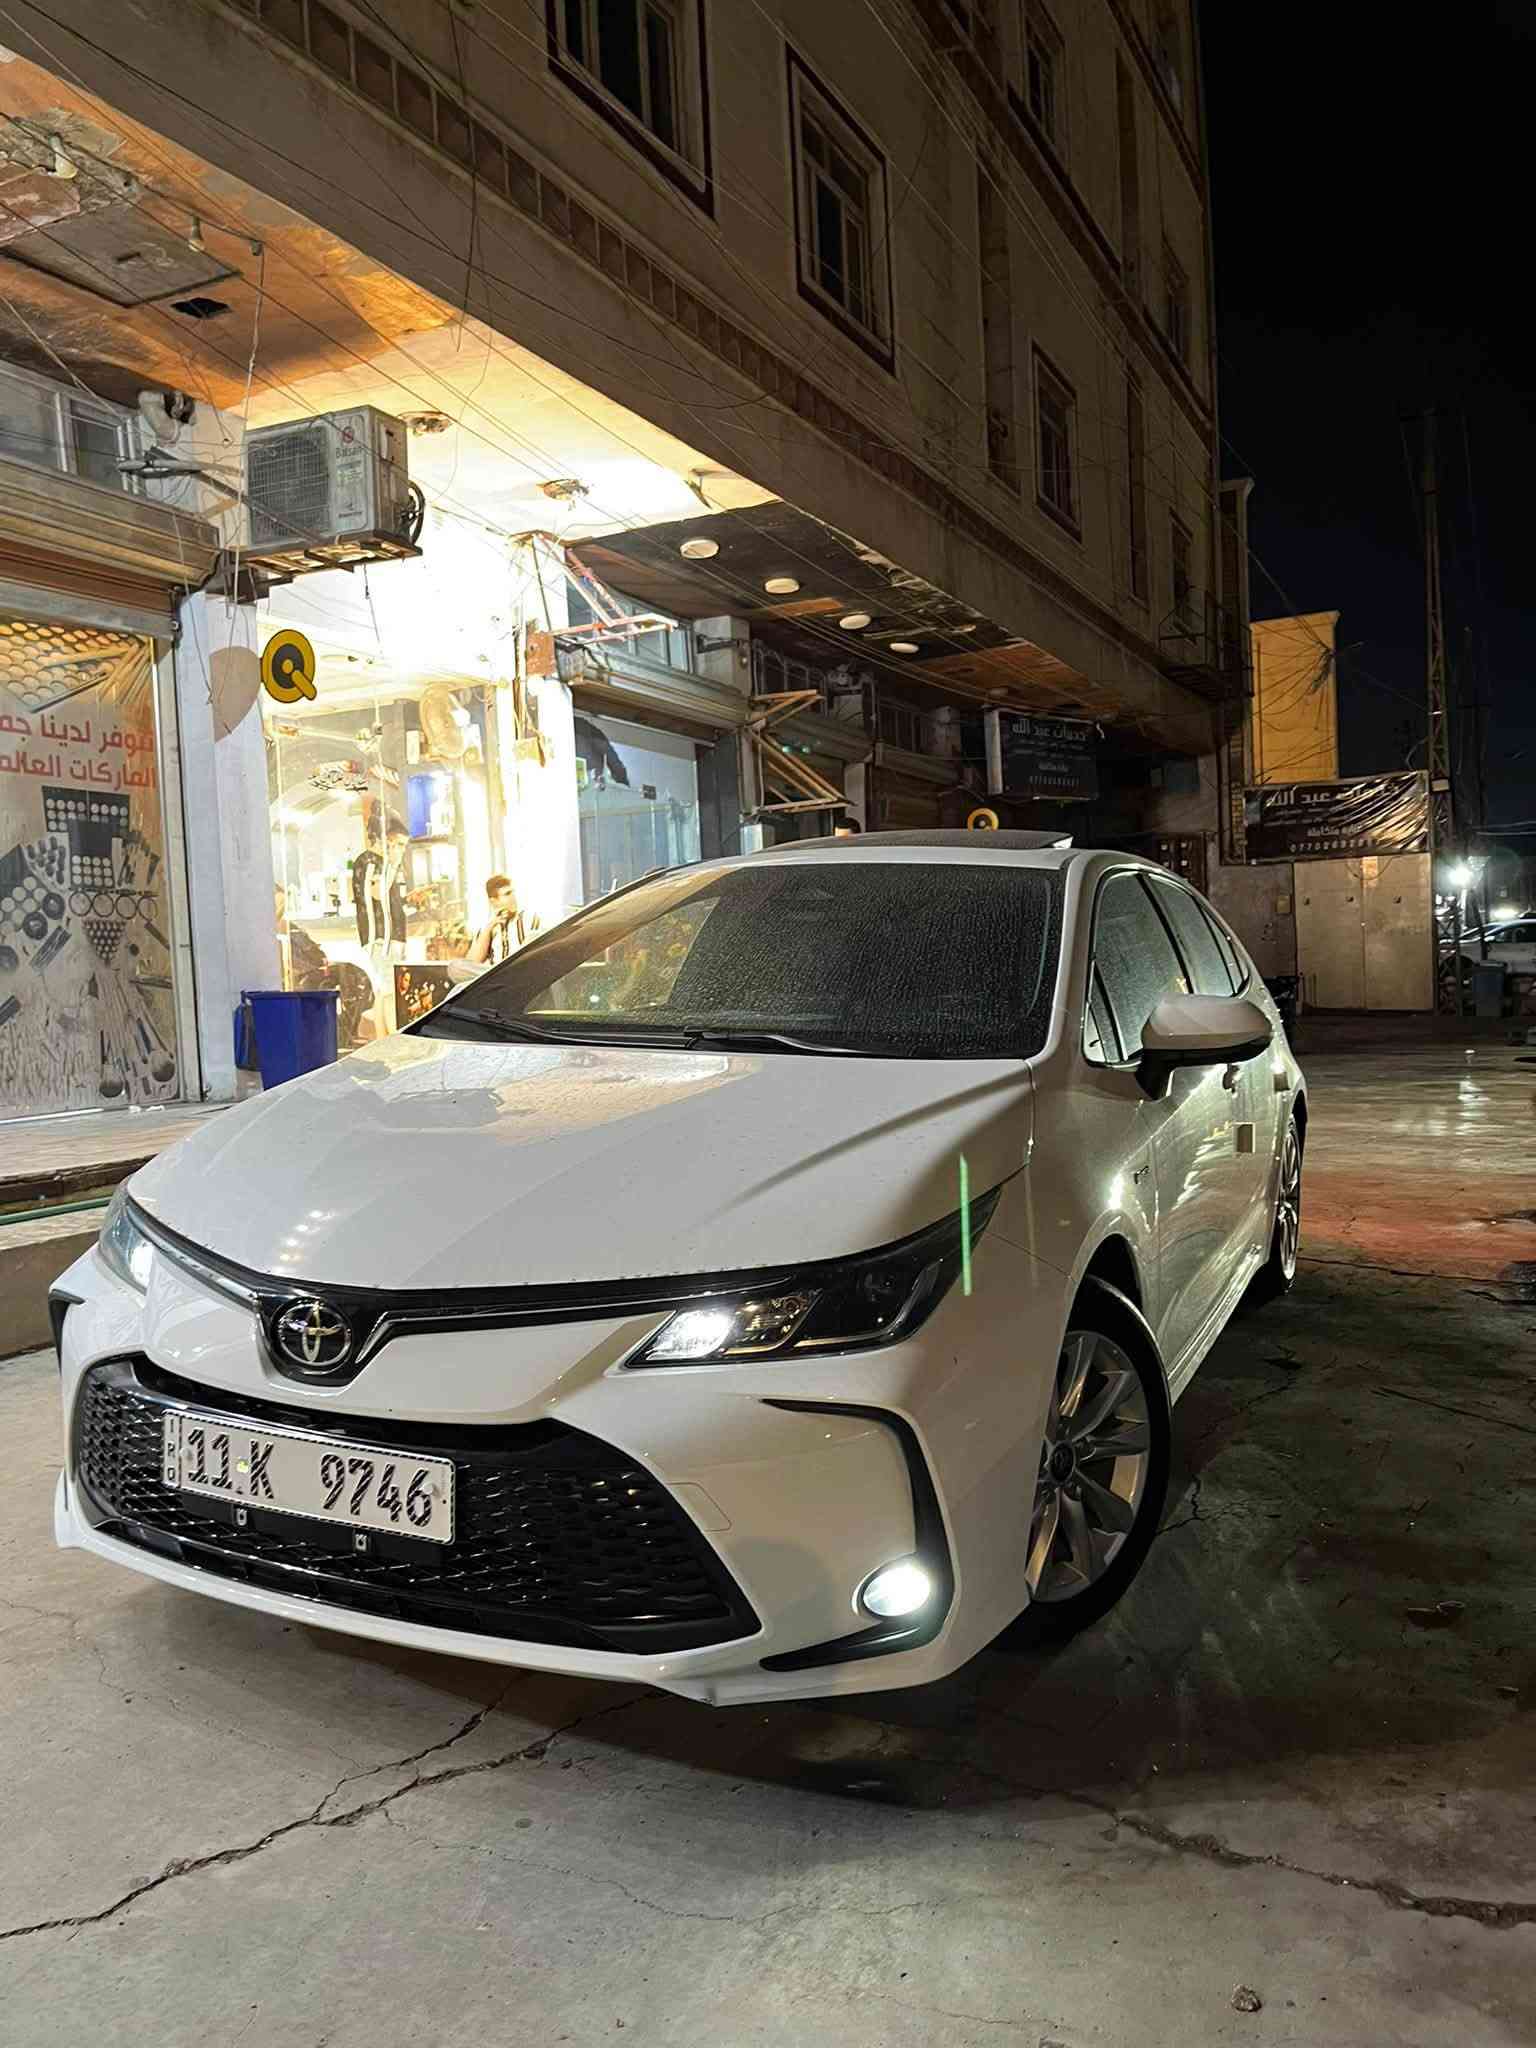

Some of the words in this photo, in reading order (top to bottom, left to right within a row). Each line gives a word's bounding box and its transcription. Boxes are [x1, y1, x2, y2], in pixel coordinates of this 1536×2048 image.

[40, 714, 91, 747] لدينا
[70, 759, 156, 791] الماركات
[1301, 793, 1332, 806] عبد
[320, 1453, 433, 1528] 9746
